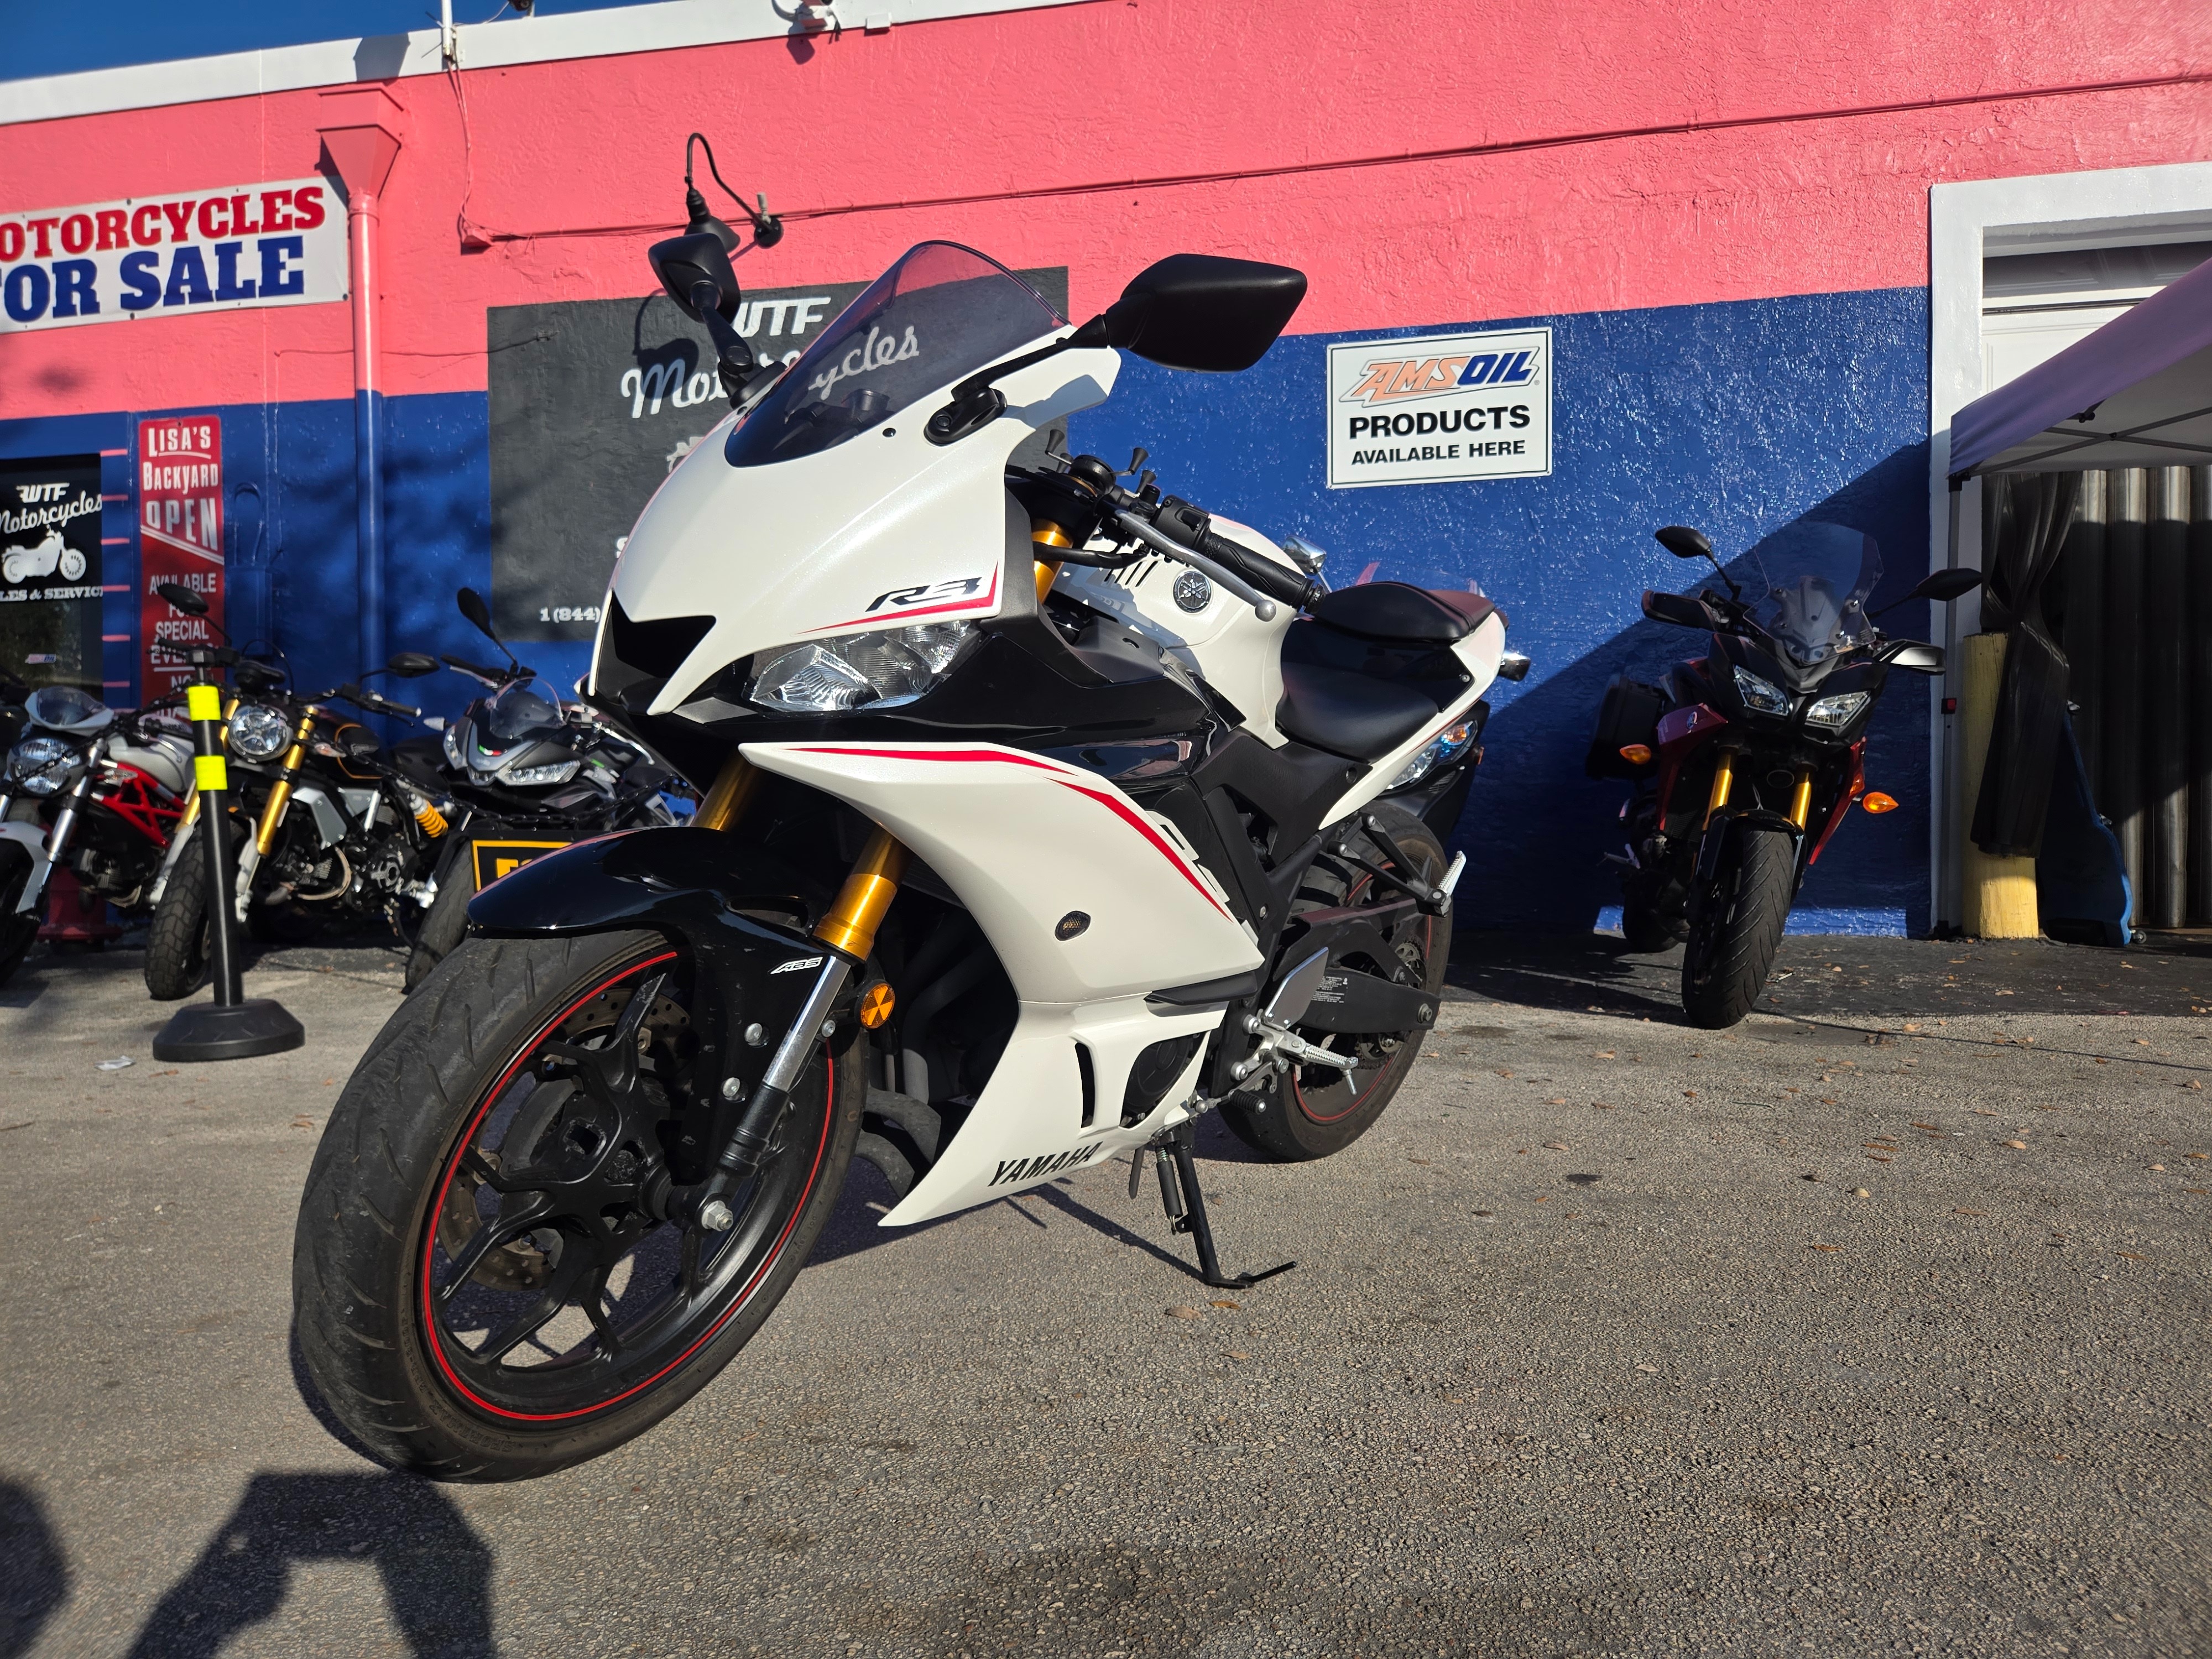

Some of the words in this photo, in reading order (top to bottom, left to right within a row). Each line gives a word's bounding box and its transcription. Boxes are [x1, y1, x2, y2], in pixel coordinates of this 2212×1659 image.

[0, 258, 100, 322] OR
[119, 235, 304, 311] SALE
[1351, 351, 1533, 403] AMSOIL
[1349, 404, 1530, 440] PRODUCTS
[148, 425, 211, 457] LISA'S
[1351, 444, 1460, 466] AVAILABLE
[1469, 440, 1526, 458] HERE
[16, 482, 70, 503] WTF
[146, 497, 218, 551] OPEN
[29, 588, 42, 601] &
[865, 577, 983, 613] R3
[155, 619, 210, 641] SPECIAL
[540, 606, 550, 622] 1
[553, 606, 601, 624] (844)
[770, 957, 823, 974] ABS
[988, 1141, 1103, 1187] YAMAHA
